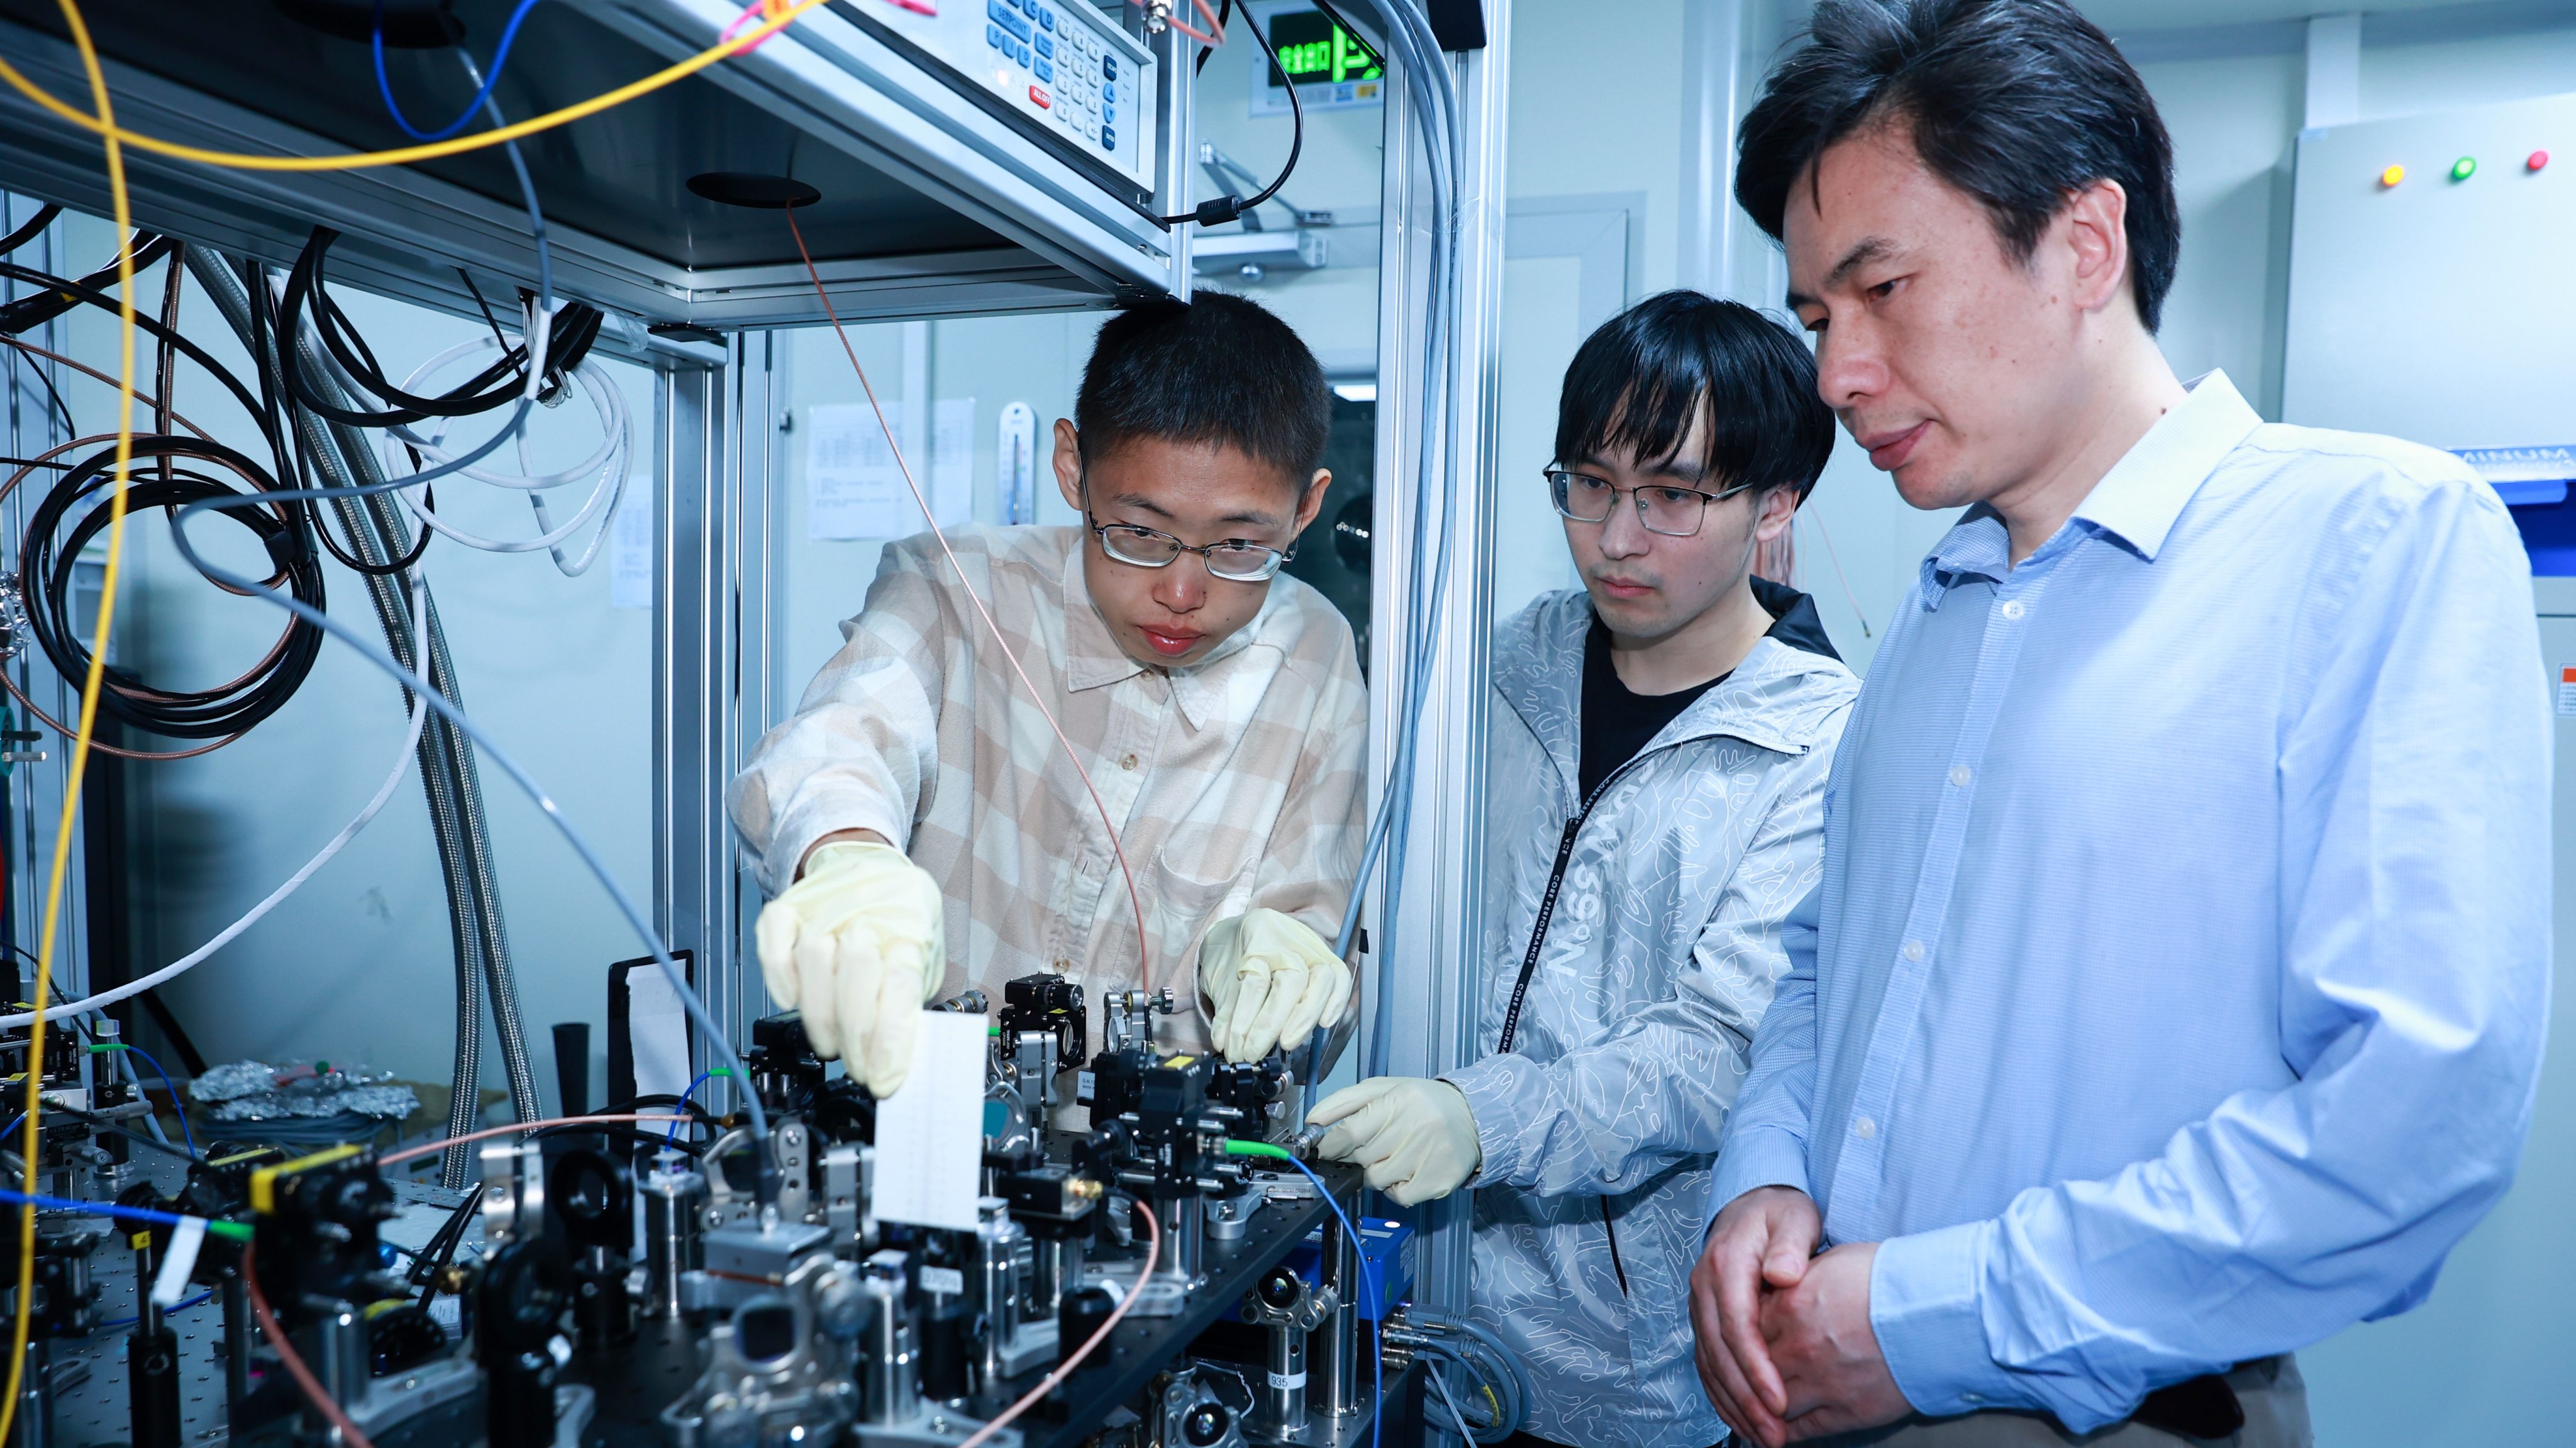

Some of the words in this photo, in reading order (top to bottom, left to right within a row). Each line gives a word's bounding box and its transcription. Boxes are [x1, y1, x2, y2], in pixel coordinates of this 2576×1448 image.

[1031, 1, 1036, 13] C
[997, 7, 1026, 35] SETPOINT
[1046, 13, 1052, 25] D
[1024, 51, 1029, 61] D
[1033, 88, 1042, 100] ALL
[1041, 94, 1051, 105] OFF
[1548, 874, 1560, 899] CORE
[1527, 900, 1551, 964] PERFORMANCE
[1512, 983, 1524, 1006] CORE
[1272, 1375, 1288, 1387] 935
